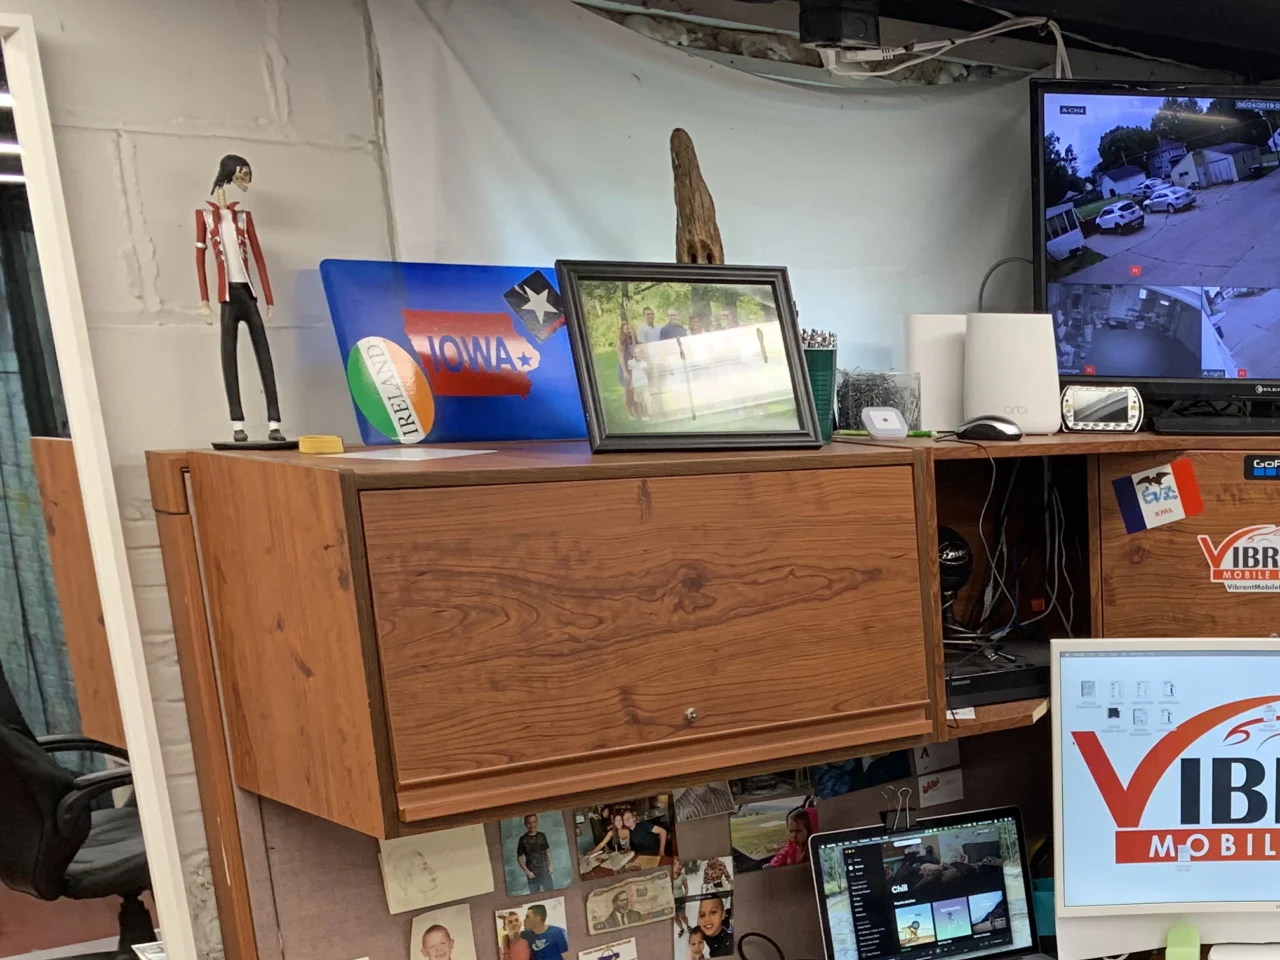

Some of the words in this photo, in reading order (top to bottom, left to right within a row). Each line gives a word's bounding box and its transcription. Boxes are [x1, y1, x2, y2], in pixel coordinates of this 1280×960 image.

[1061, 106, 1085, 114] A-CH4
[427, 335, 518, 373] IOWA
[366, 343, 419, 437] IRELAND
[1003, 405, 1028, 416] orbi
[1154, 506, 1174, 518] IOWA
[1222, 570, 1270, 580] MOBILE
[892, 884, 908, 894] Chill
